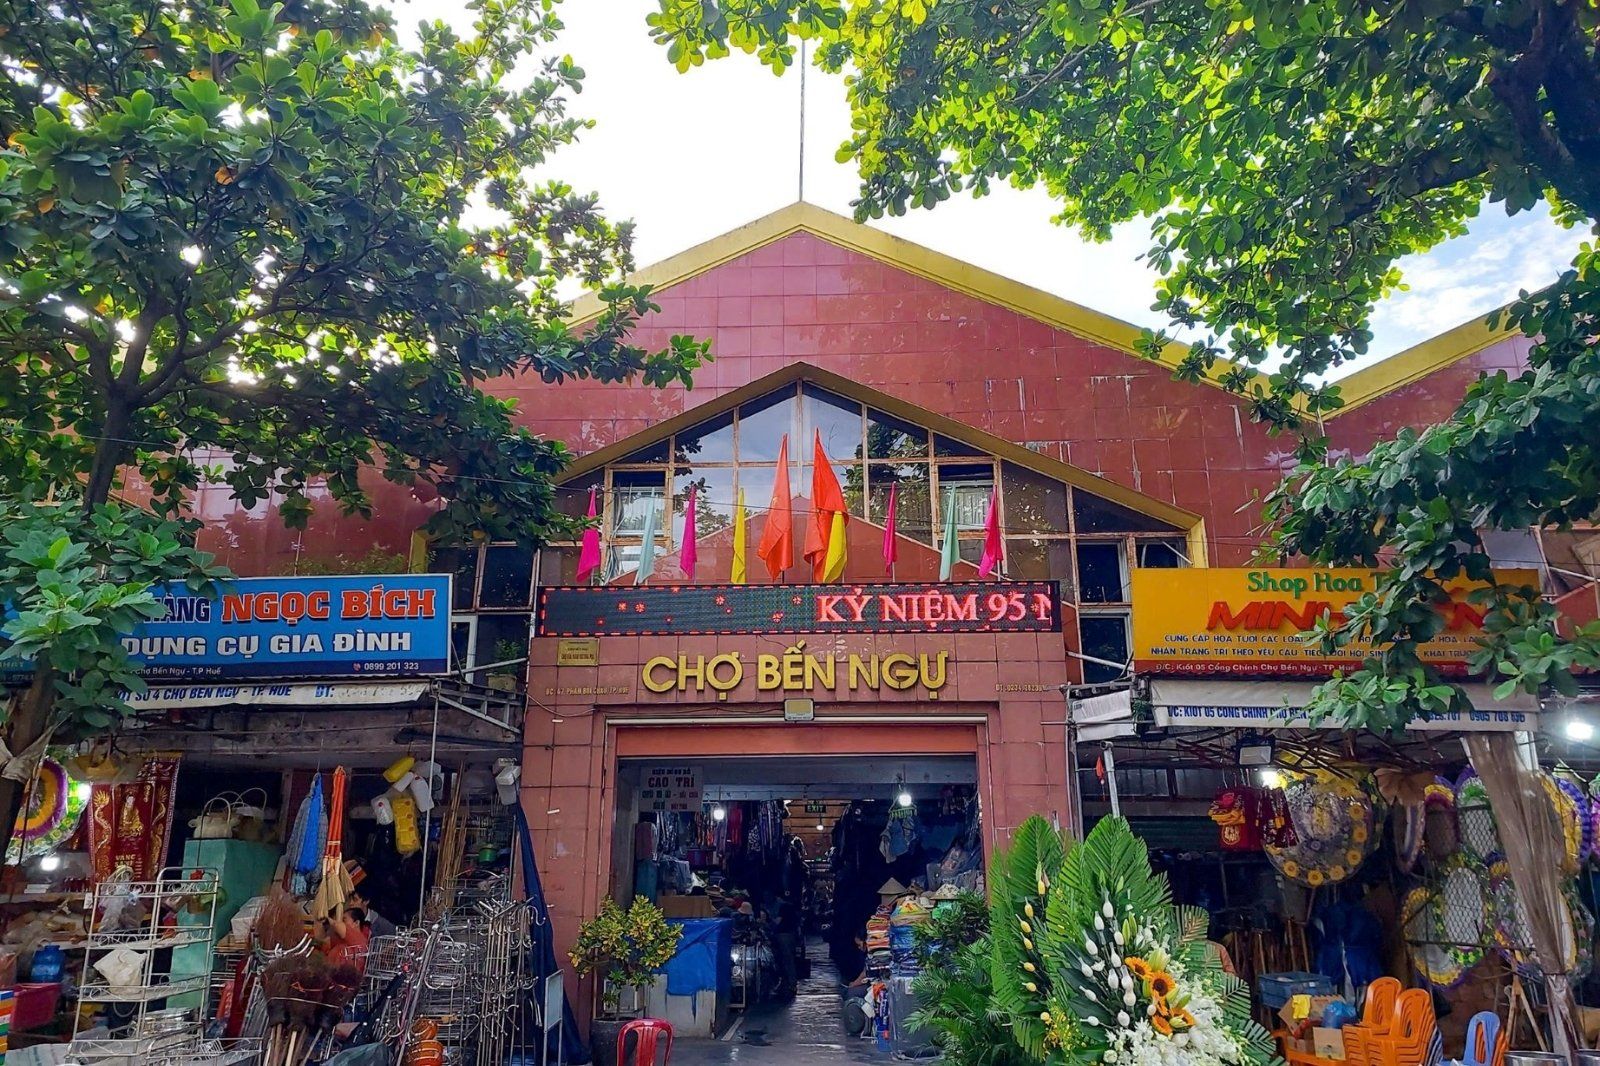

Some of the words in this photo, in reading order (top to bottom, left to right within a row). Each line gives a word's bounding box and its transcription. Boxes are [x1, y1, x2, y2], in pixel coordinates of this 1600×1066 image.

[1247, 571, 1308, 599] Shop
[1314, 572, 1362, 592] Hoa
[221, 590, 330, 625] NGỌC
[340, 584, 436, 619] BÍCH
[816, 588, 873, 622] KỶ
[879, 589, 980, 629] NIỆM
[988, 593, 1027, 622] 95
[120, 637, 206, 660] DỤNG
[217, 634, 260, 659] CỤ
[269, 633, 324, 654] GIA
[332, 629, 411, 653] ĐÌNH
[1164, 634, 1189, 643] CUNG
[1213, 635, 1233, 643] HOA
[364, 662, 385, 671] 0899
[386, 662, 401, 671] 201
[403, 662, 419, 670] 323
[642, 650, 744, 701] CHỢ
[757, 639, 836, 691] BẾN
[849, 649, 949, 700] NGỰ
[647, 776, 669, 788] CAO
